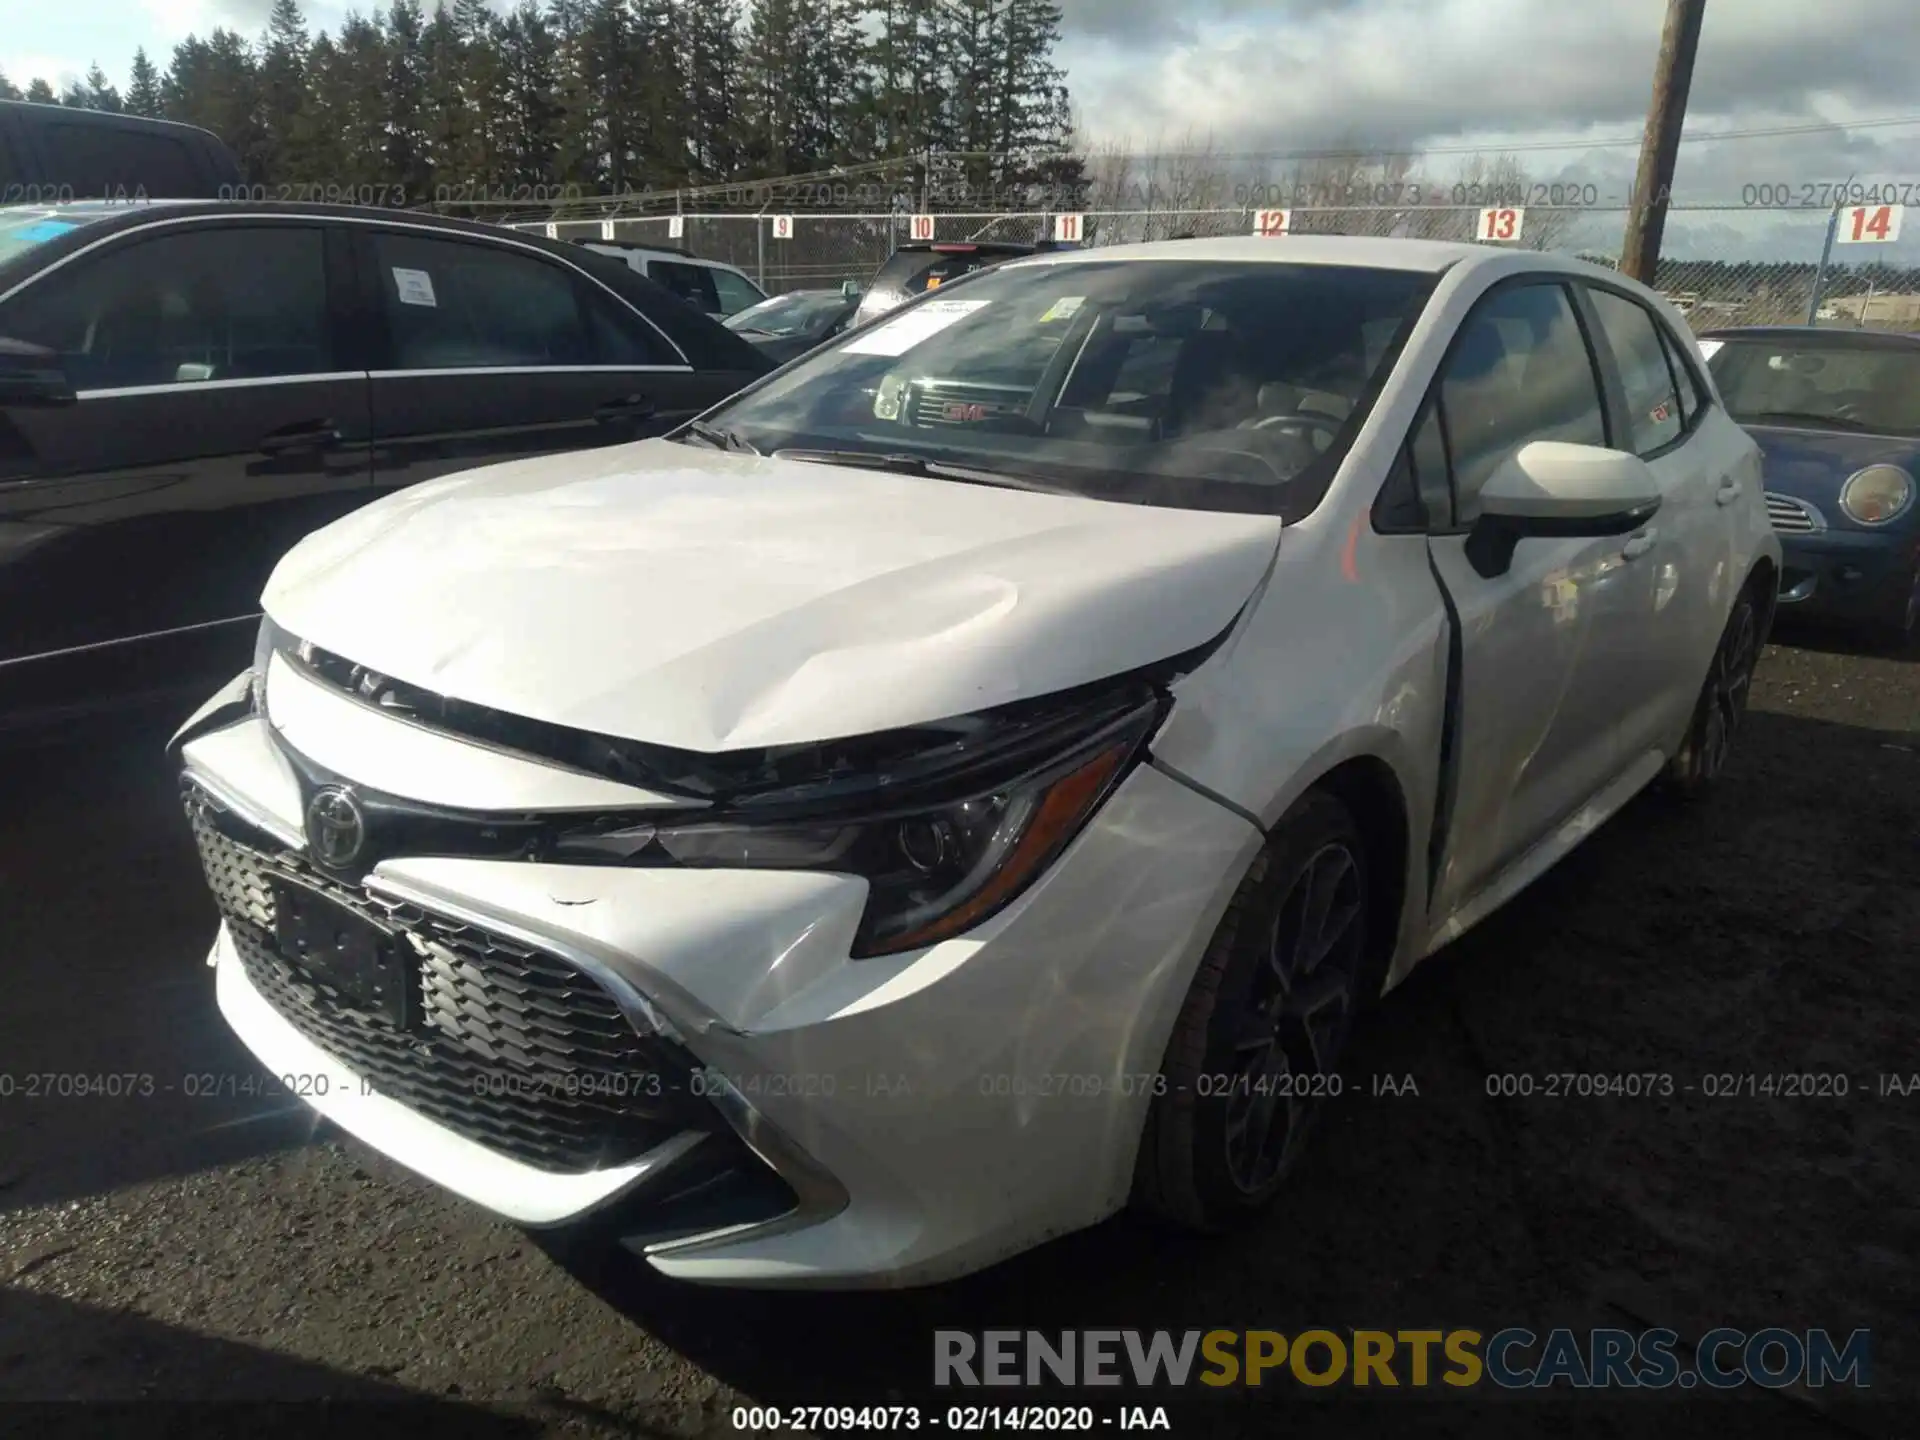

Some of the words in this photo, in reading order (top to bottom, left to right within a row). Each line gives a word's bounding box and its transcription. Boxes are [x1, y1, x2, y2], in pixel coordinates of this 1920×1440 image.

[778, 217, 788, 236] 9
[914, 216, 931, 238] 10
[1062, 216, 1077, 240] 11
[1261, 212, 1284, 236] 12
[1487, 210, 1516, 239] 13
[1851, 206, 1891, 241] 14
